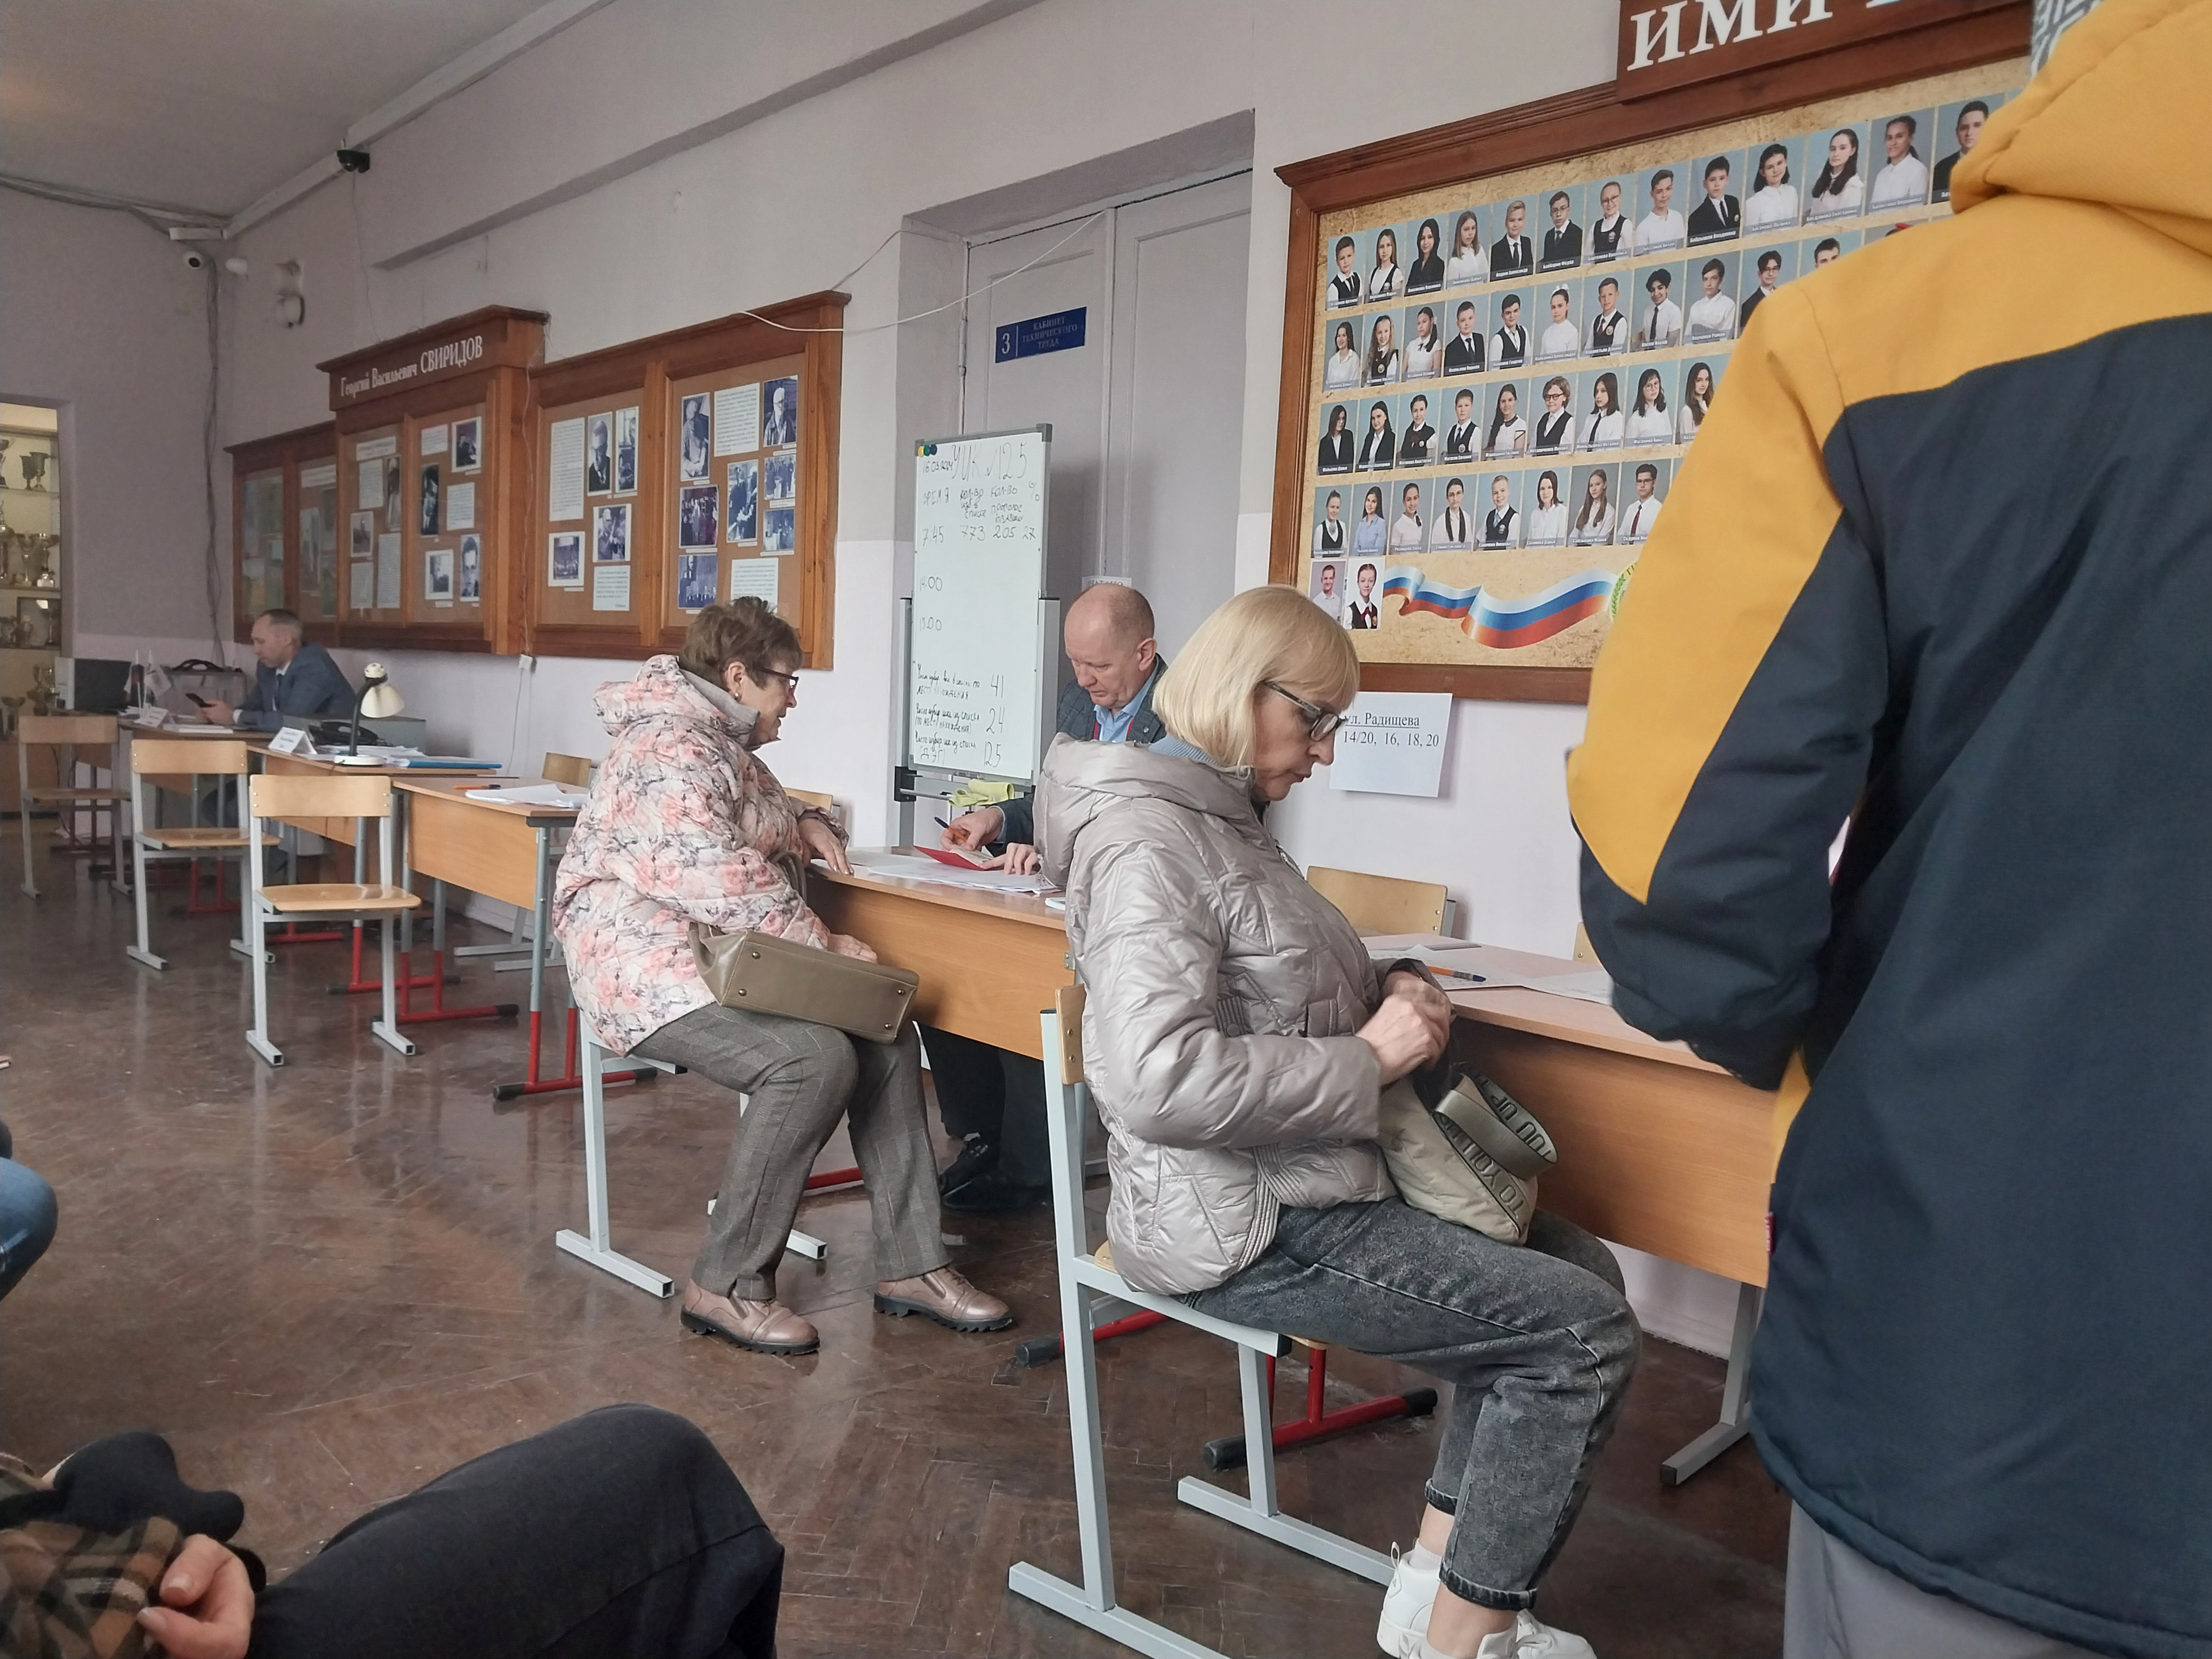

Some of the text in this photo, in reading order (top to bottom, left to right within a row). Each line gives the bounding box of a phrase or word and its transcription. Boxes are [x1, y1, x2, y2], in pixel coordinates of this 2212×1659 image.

[1022, 324, 1077, 343] ТЕХНИЧЕСКОГО
[1033, 316, 1065, 331] КАБИНЕТ
[1001, 333, 1010, 354] 3
[1038, 337, 1059, 349] ТРУДА
[340, 335, 483, 398] Георгий Васильевич СВИРИДОВ
[993, 525, 1017, 539] 205
[990, 674, 1004, 698] 41
[986, 706, 1005, 734] 24
[1365, 712, 1420, 727] Радищева
[1343, 731, 1439, 748] 14/20, 16, 18, 20
[983, 741, 1002, 768] 125
[1499, 1186, 1524, 1219] TO
